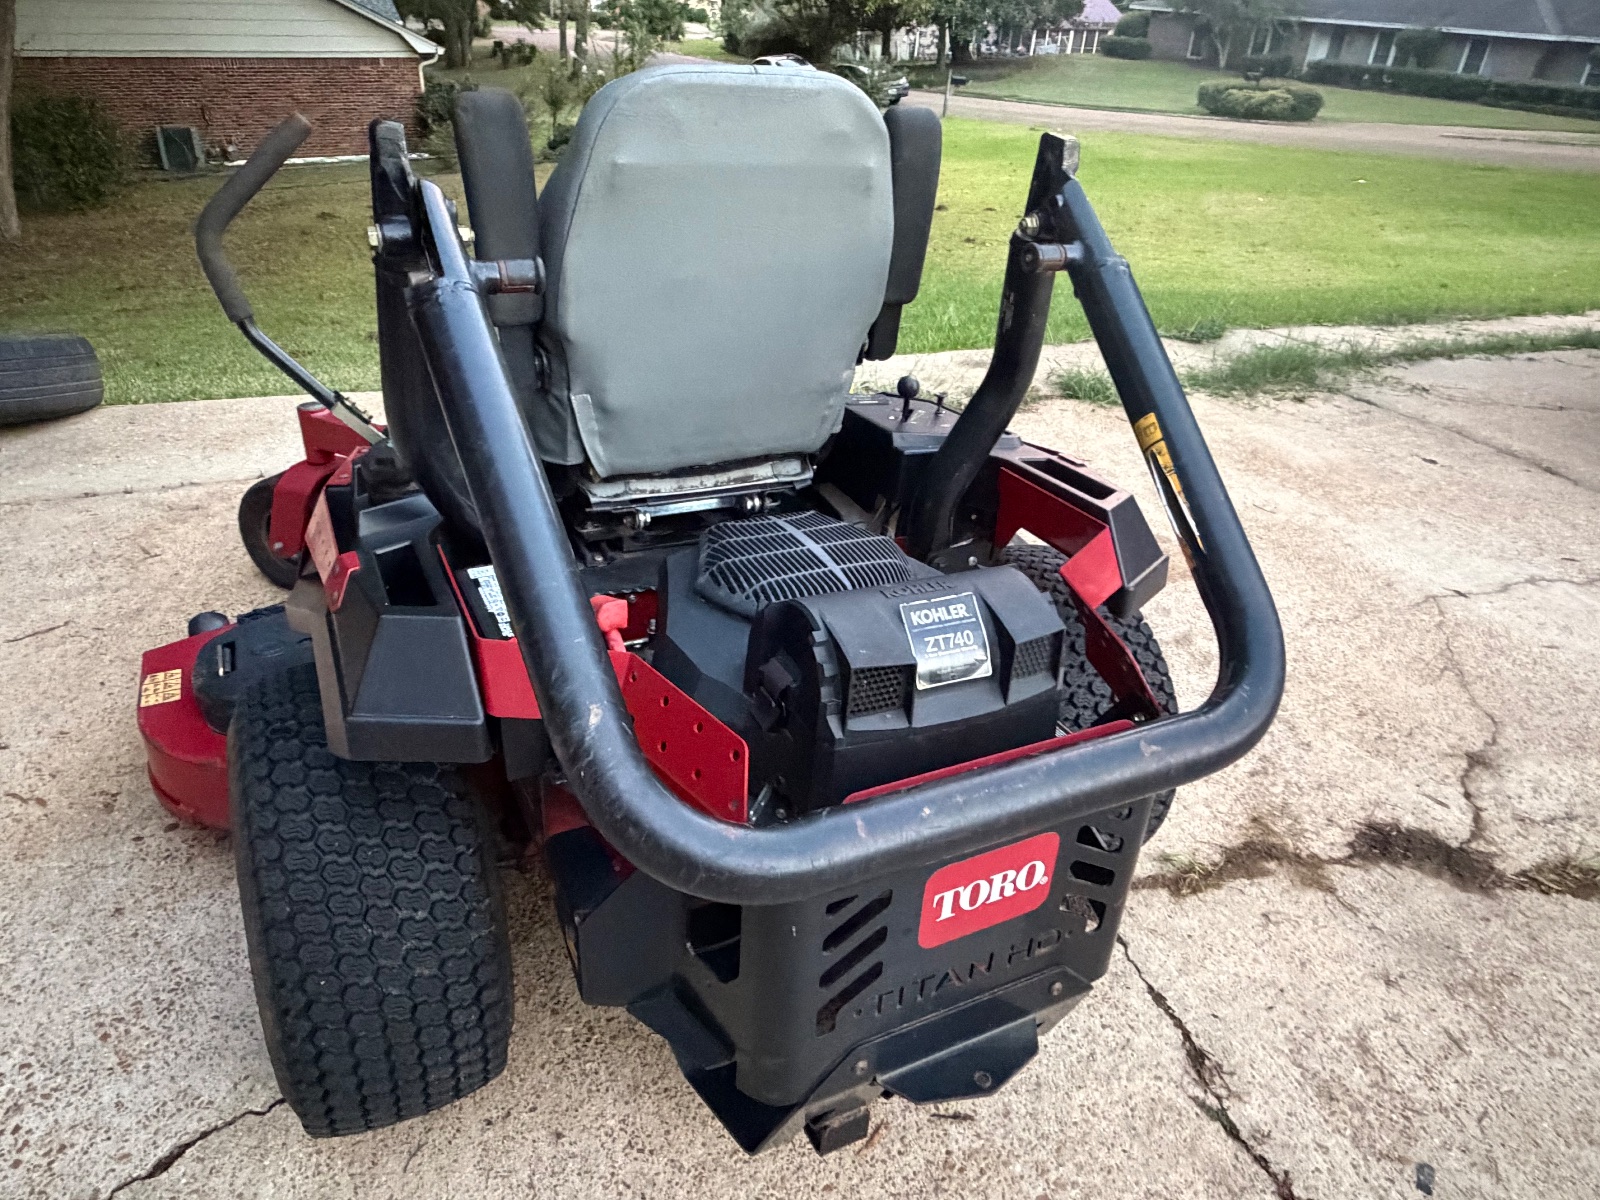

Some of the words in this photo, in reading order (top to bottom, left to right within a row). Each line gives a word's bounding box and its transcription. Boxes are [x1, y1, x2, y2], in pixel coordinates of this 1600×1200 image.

[910, 603, 970, 626] KOHLER
[924, 629, 974, 653] ZT740
[932, 860, 1046, 922] TORO
[875, 951, 995, 1017] TITAN
[1007, 928, 1062, 967] HD
